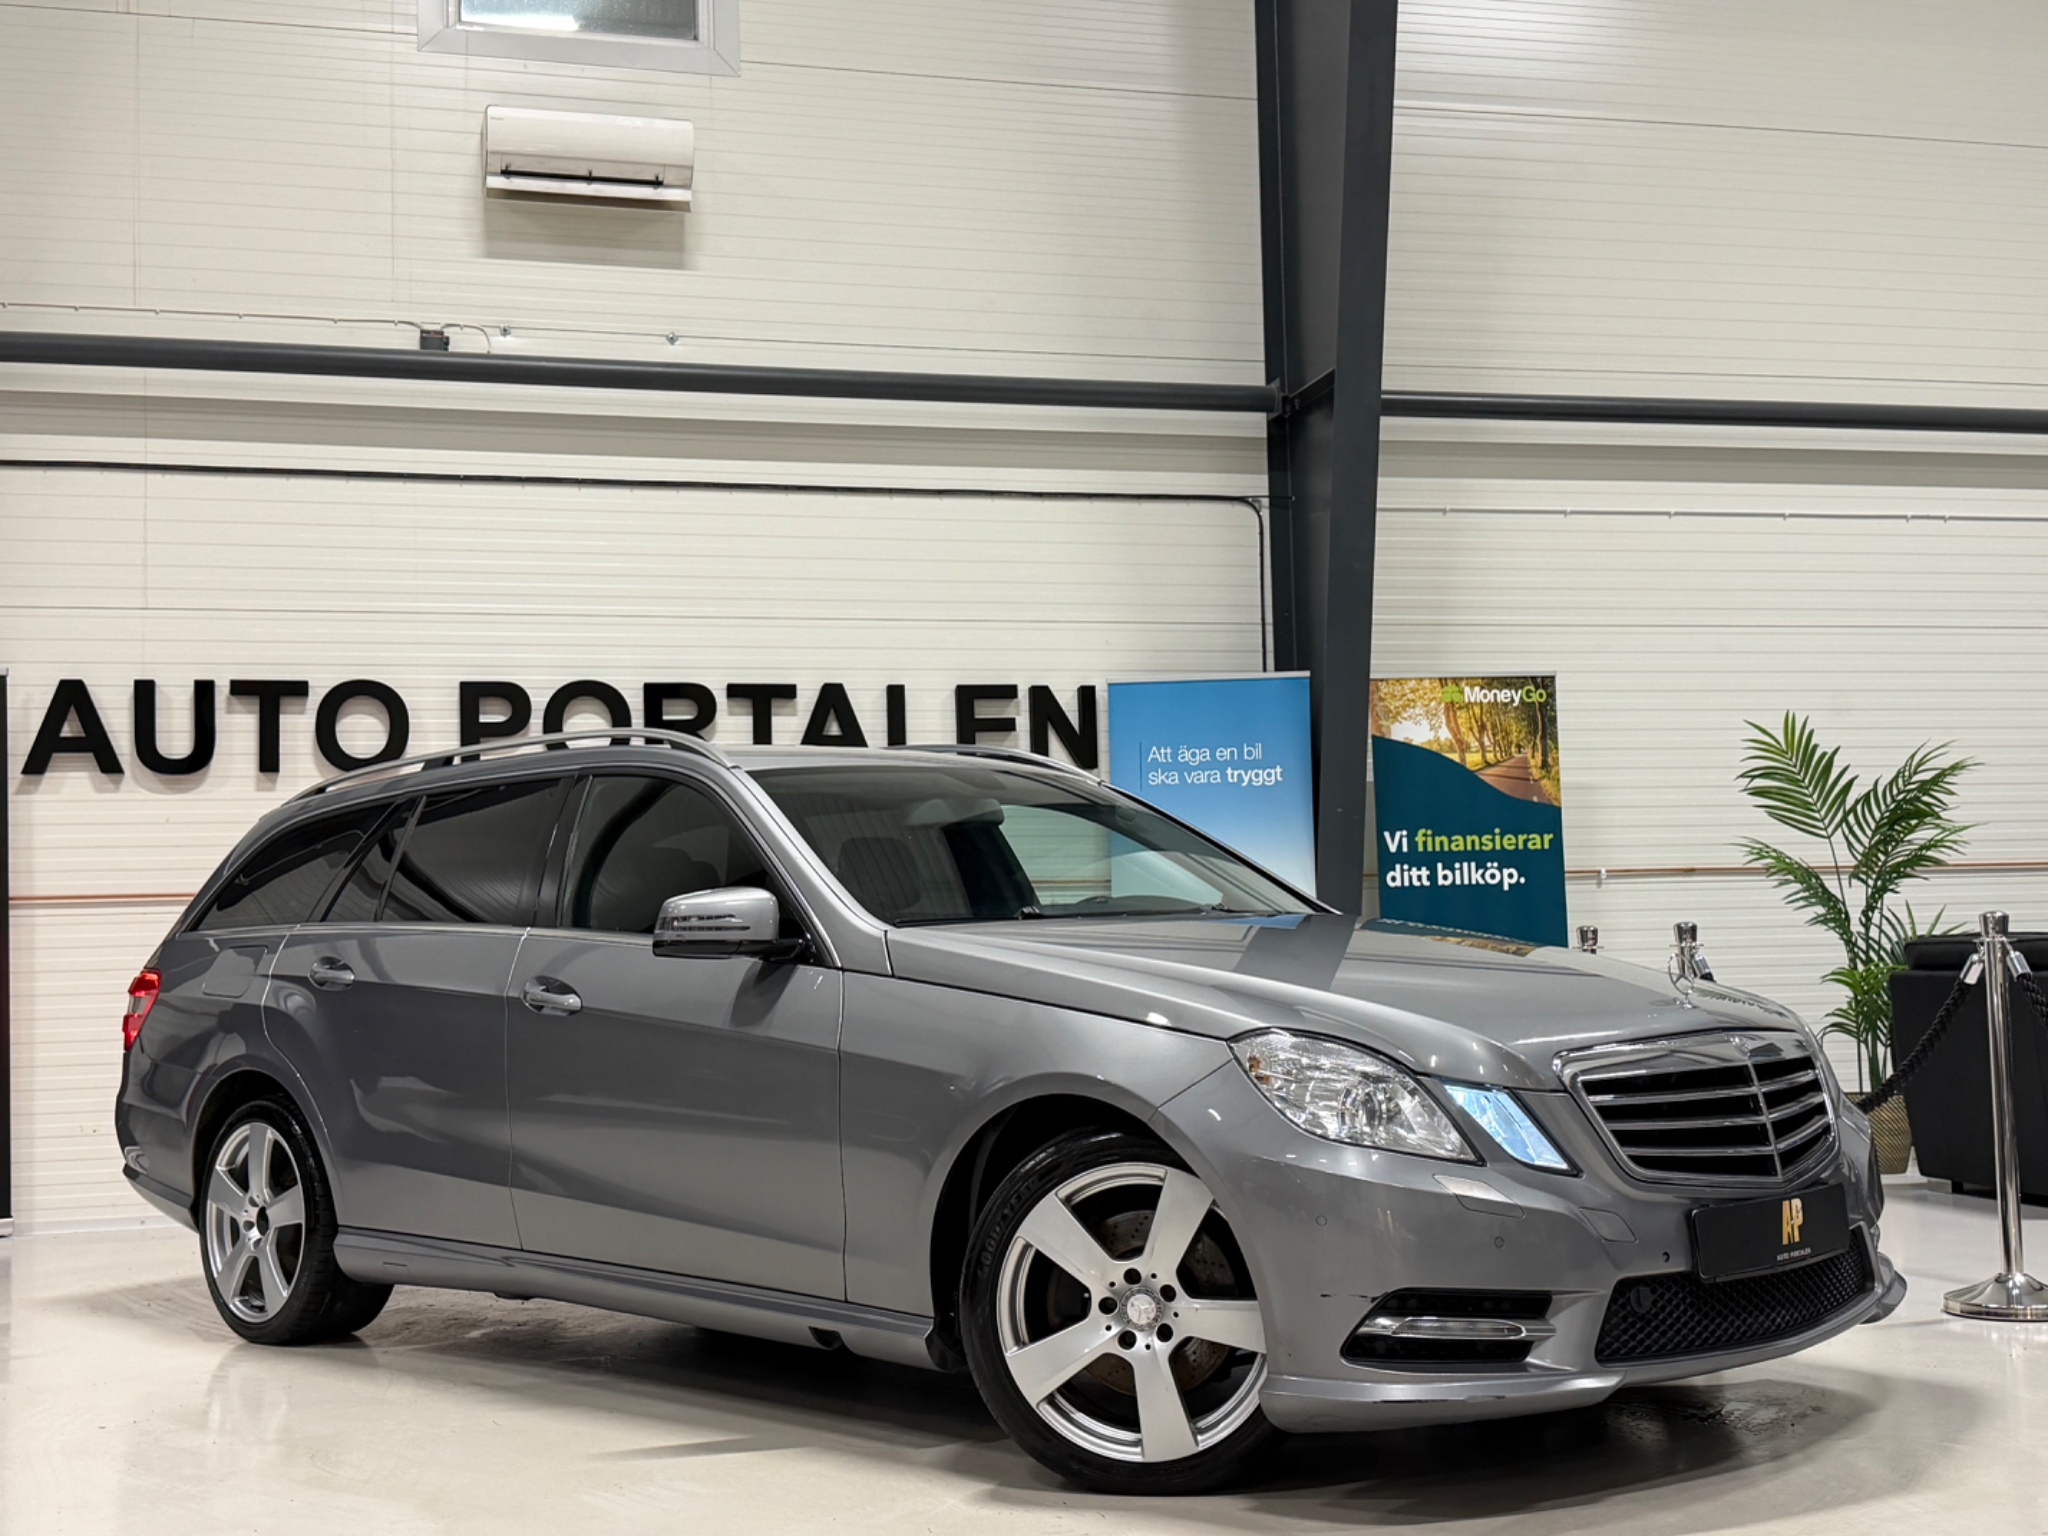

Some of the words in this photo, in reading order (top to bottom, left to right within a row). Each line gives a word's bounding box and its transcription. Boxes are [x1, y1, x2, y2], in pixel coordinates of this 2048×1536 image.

[1463, 685, 1547, 707] MoneyGo
[21, 679, 410, 775] AUTO
[1147, 745, 1173, 763] Att
[1177, 744, 1211, 766] äga
[1215, 746, 1238, 761] en
[1243, 743, 1263, 761] bil
[1148, 768, 1179, 785] ska
[1184, 769, 1221, 784] vara
[1226, 765, 1283, 787] tryggt
[1383, 829, 1408, 853] Vi
[1414, 828, 1554, 852] finansierar
[1385, 863, 1431, 888] ditt
[1436, 861, 1526, 891] bilköp.
